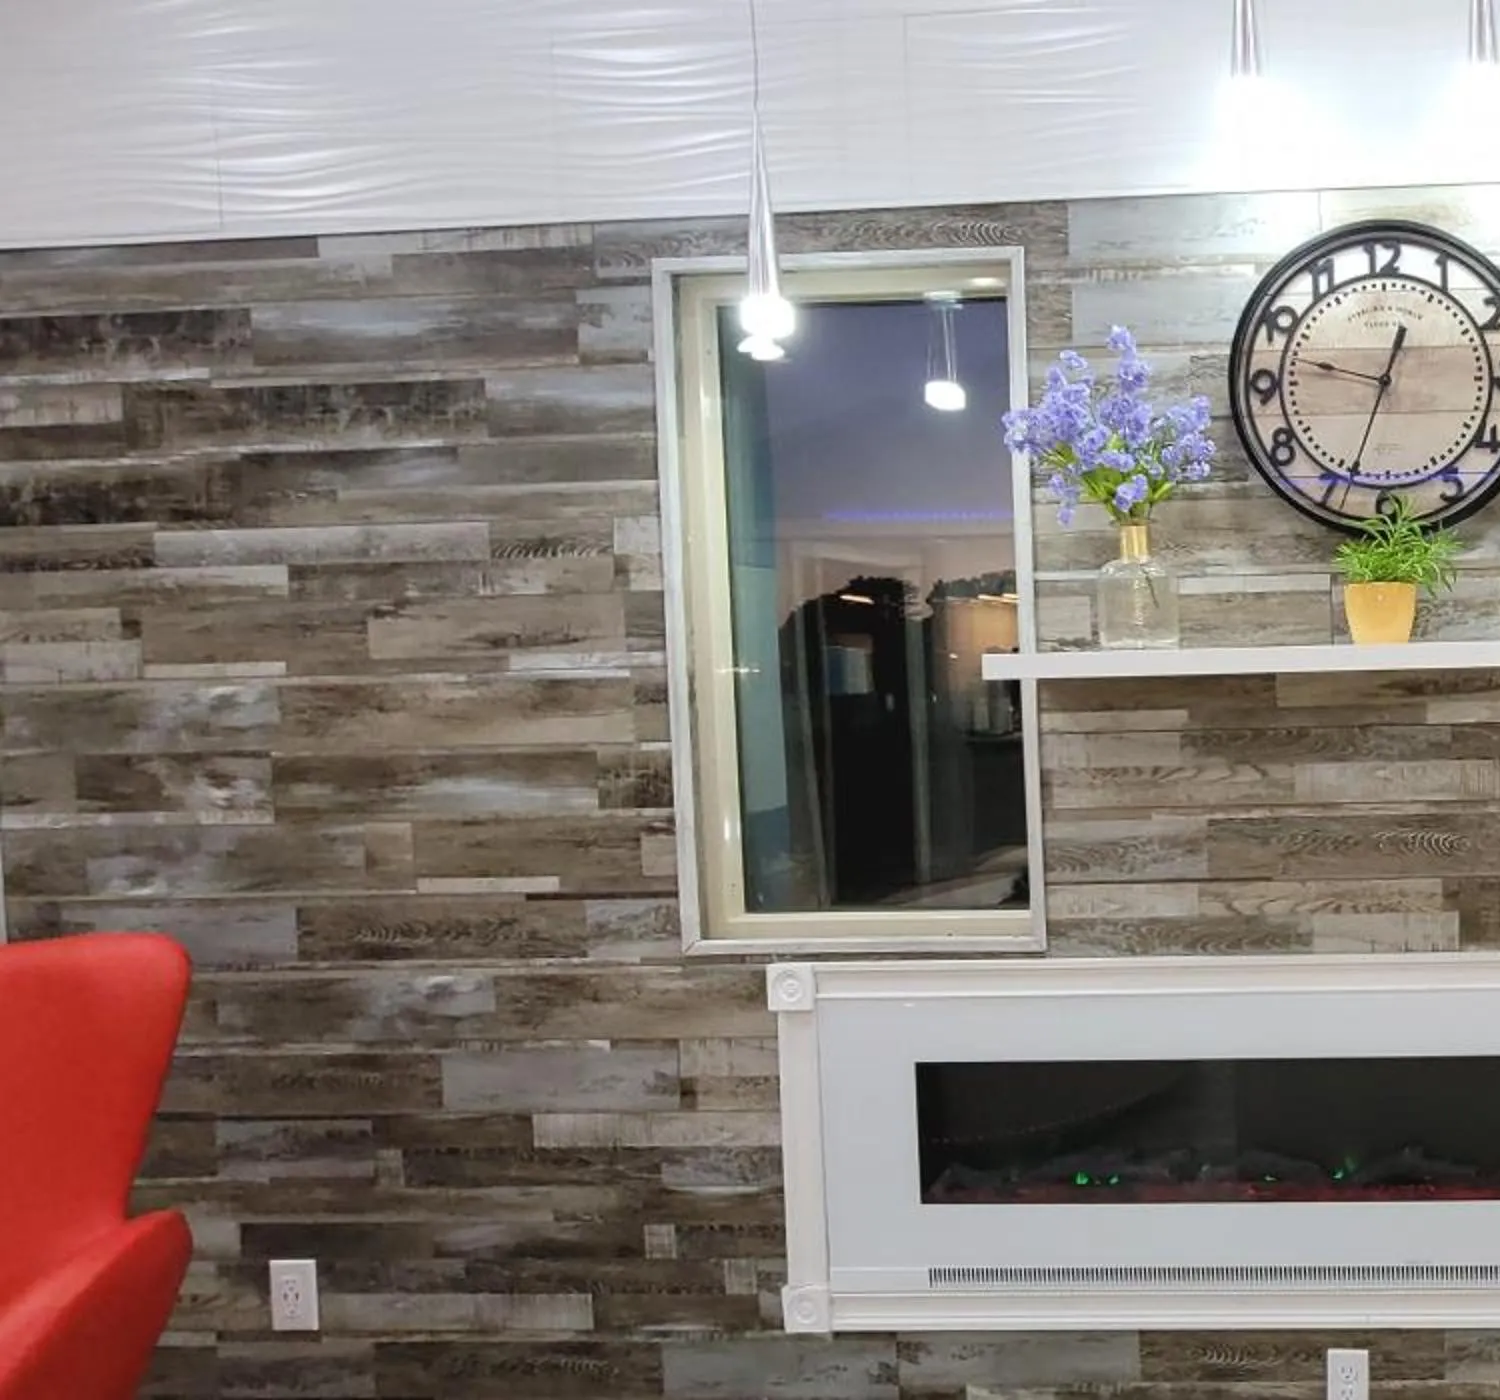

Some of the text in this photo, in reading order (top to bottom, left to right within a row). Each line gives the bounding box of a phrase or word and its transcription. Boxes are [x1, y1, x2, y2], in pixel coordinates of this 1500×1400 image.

[1360, 241, 1401, 276] 12
[1435, 249, 1449, 292] 1
[1309, 257, 1334, 303] 11
[1262, 305, 1299, 344] 10
[1250, 368, 1278, 406] 9
[1271, 427, 1296, 466] 8
[1319, 472, 1339, 505] 7
[1440, 467, 1464, 502] 5
